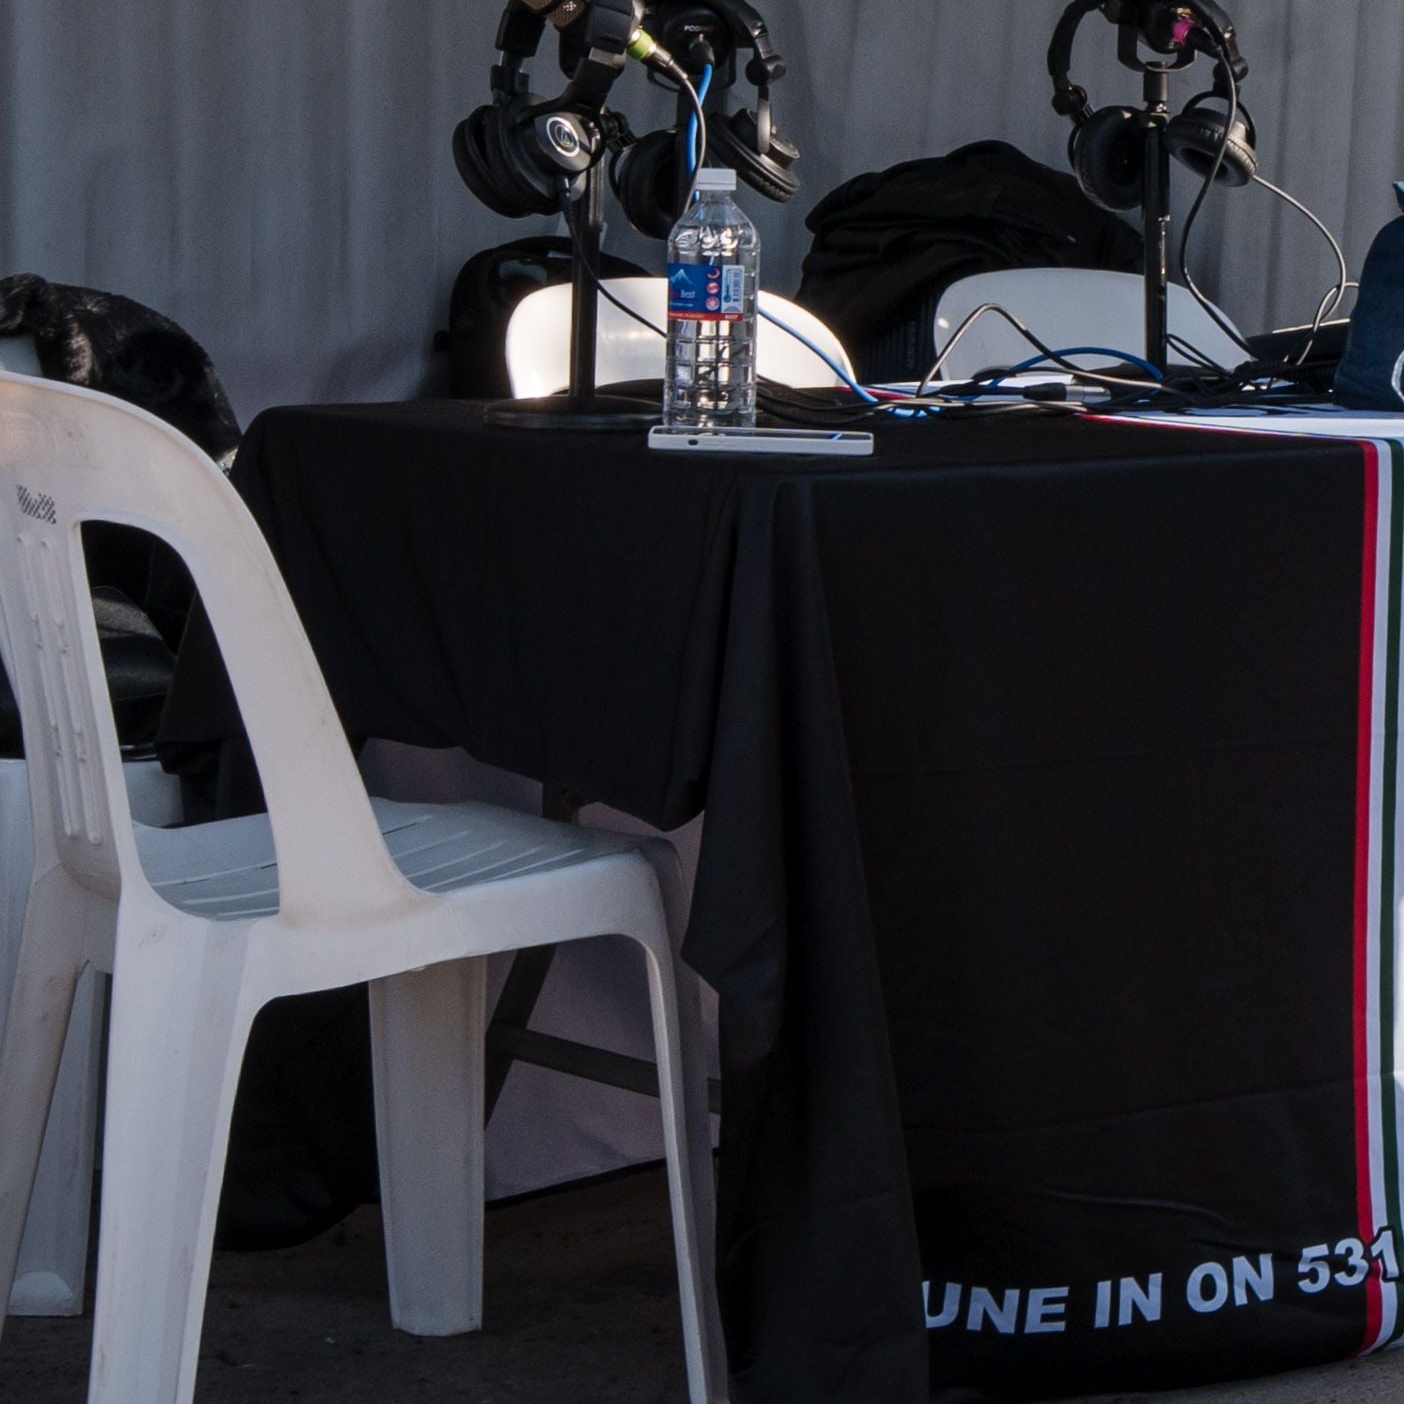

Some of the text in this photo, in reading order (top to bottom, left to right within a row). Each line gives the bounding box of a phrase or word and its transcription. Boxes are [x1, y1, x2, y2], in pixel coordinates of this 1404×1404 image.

[921, 1279, 1070, 1335] UNE
[1093, 1271, 1163, 1329] IN
[1184, 1251, 1275, 1314] ON
